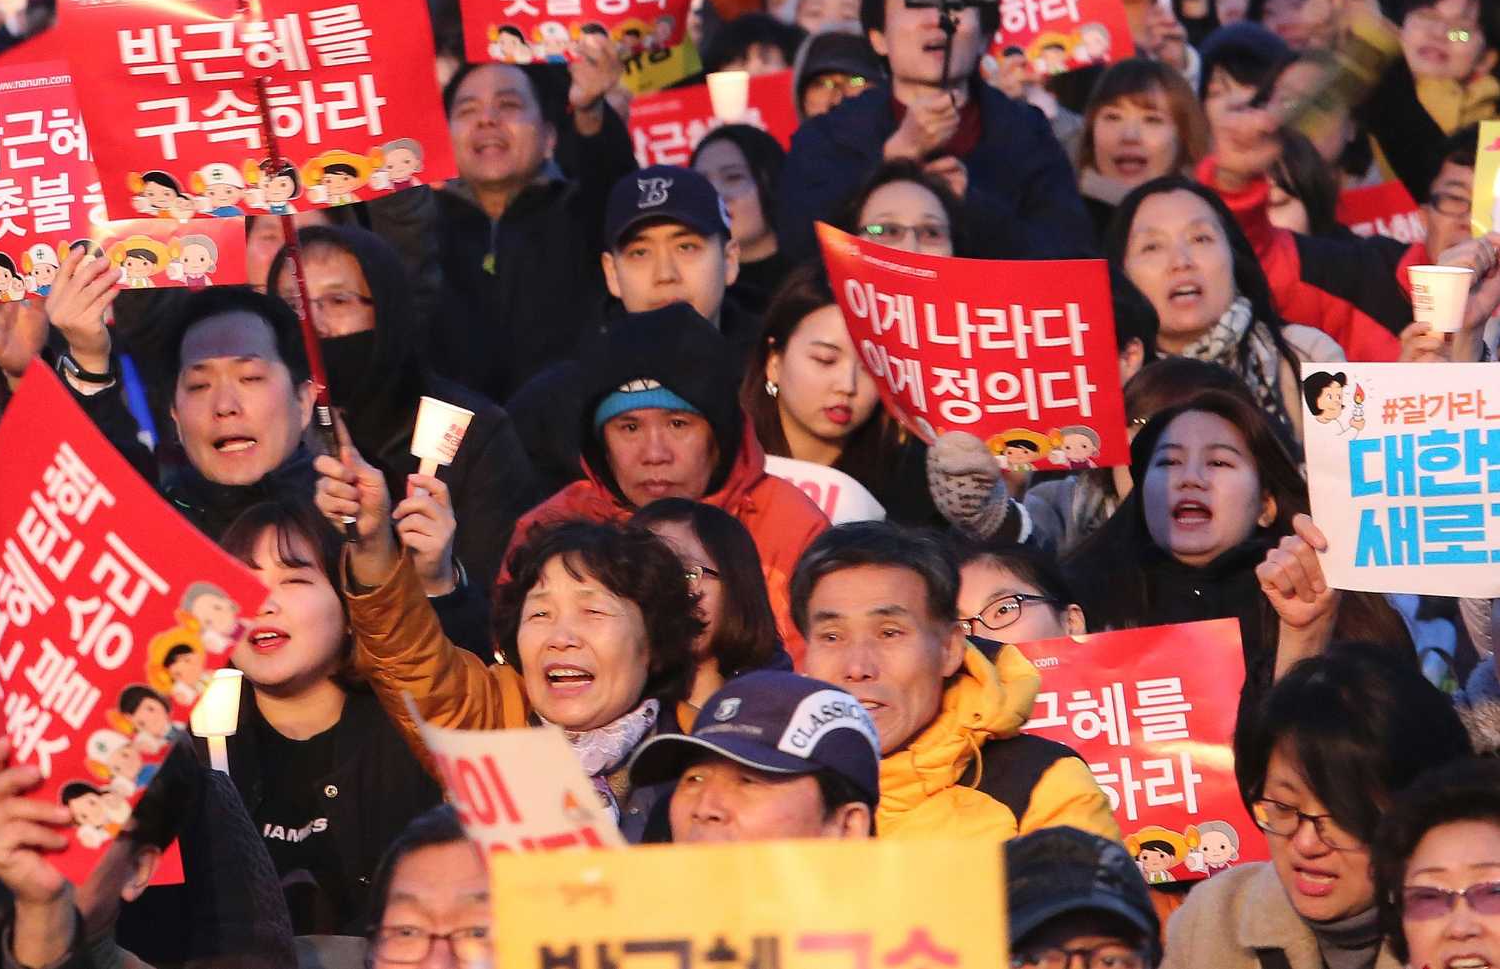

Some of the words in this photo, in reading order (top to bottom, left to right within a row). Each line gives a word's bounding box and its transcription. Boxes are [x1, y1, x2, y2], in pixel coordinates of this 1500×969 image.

[117, 2, 373, 86] 박근혜를
[133, 72, 388, 161] 구속하라
[843, 278, 920, 350] 이게
[922, 301, 1091, 360] 나라다
[861, 338, 929, 414] 이게
[930, 363, 1098, 426] 정의다
[15, 440, 116, 582] 탄핵
[1353, 502, 1500, 569] 새로
[3, 635, 102, 781] 촛불
[63, 530, 171, 672] 승리
